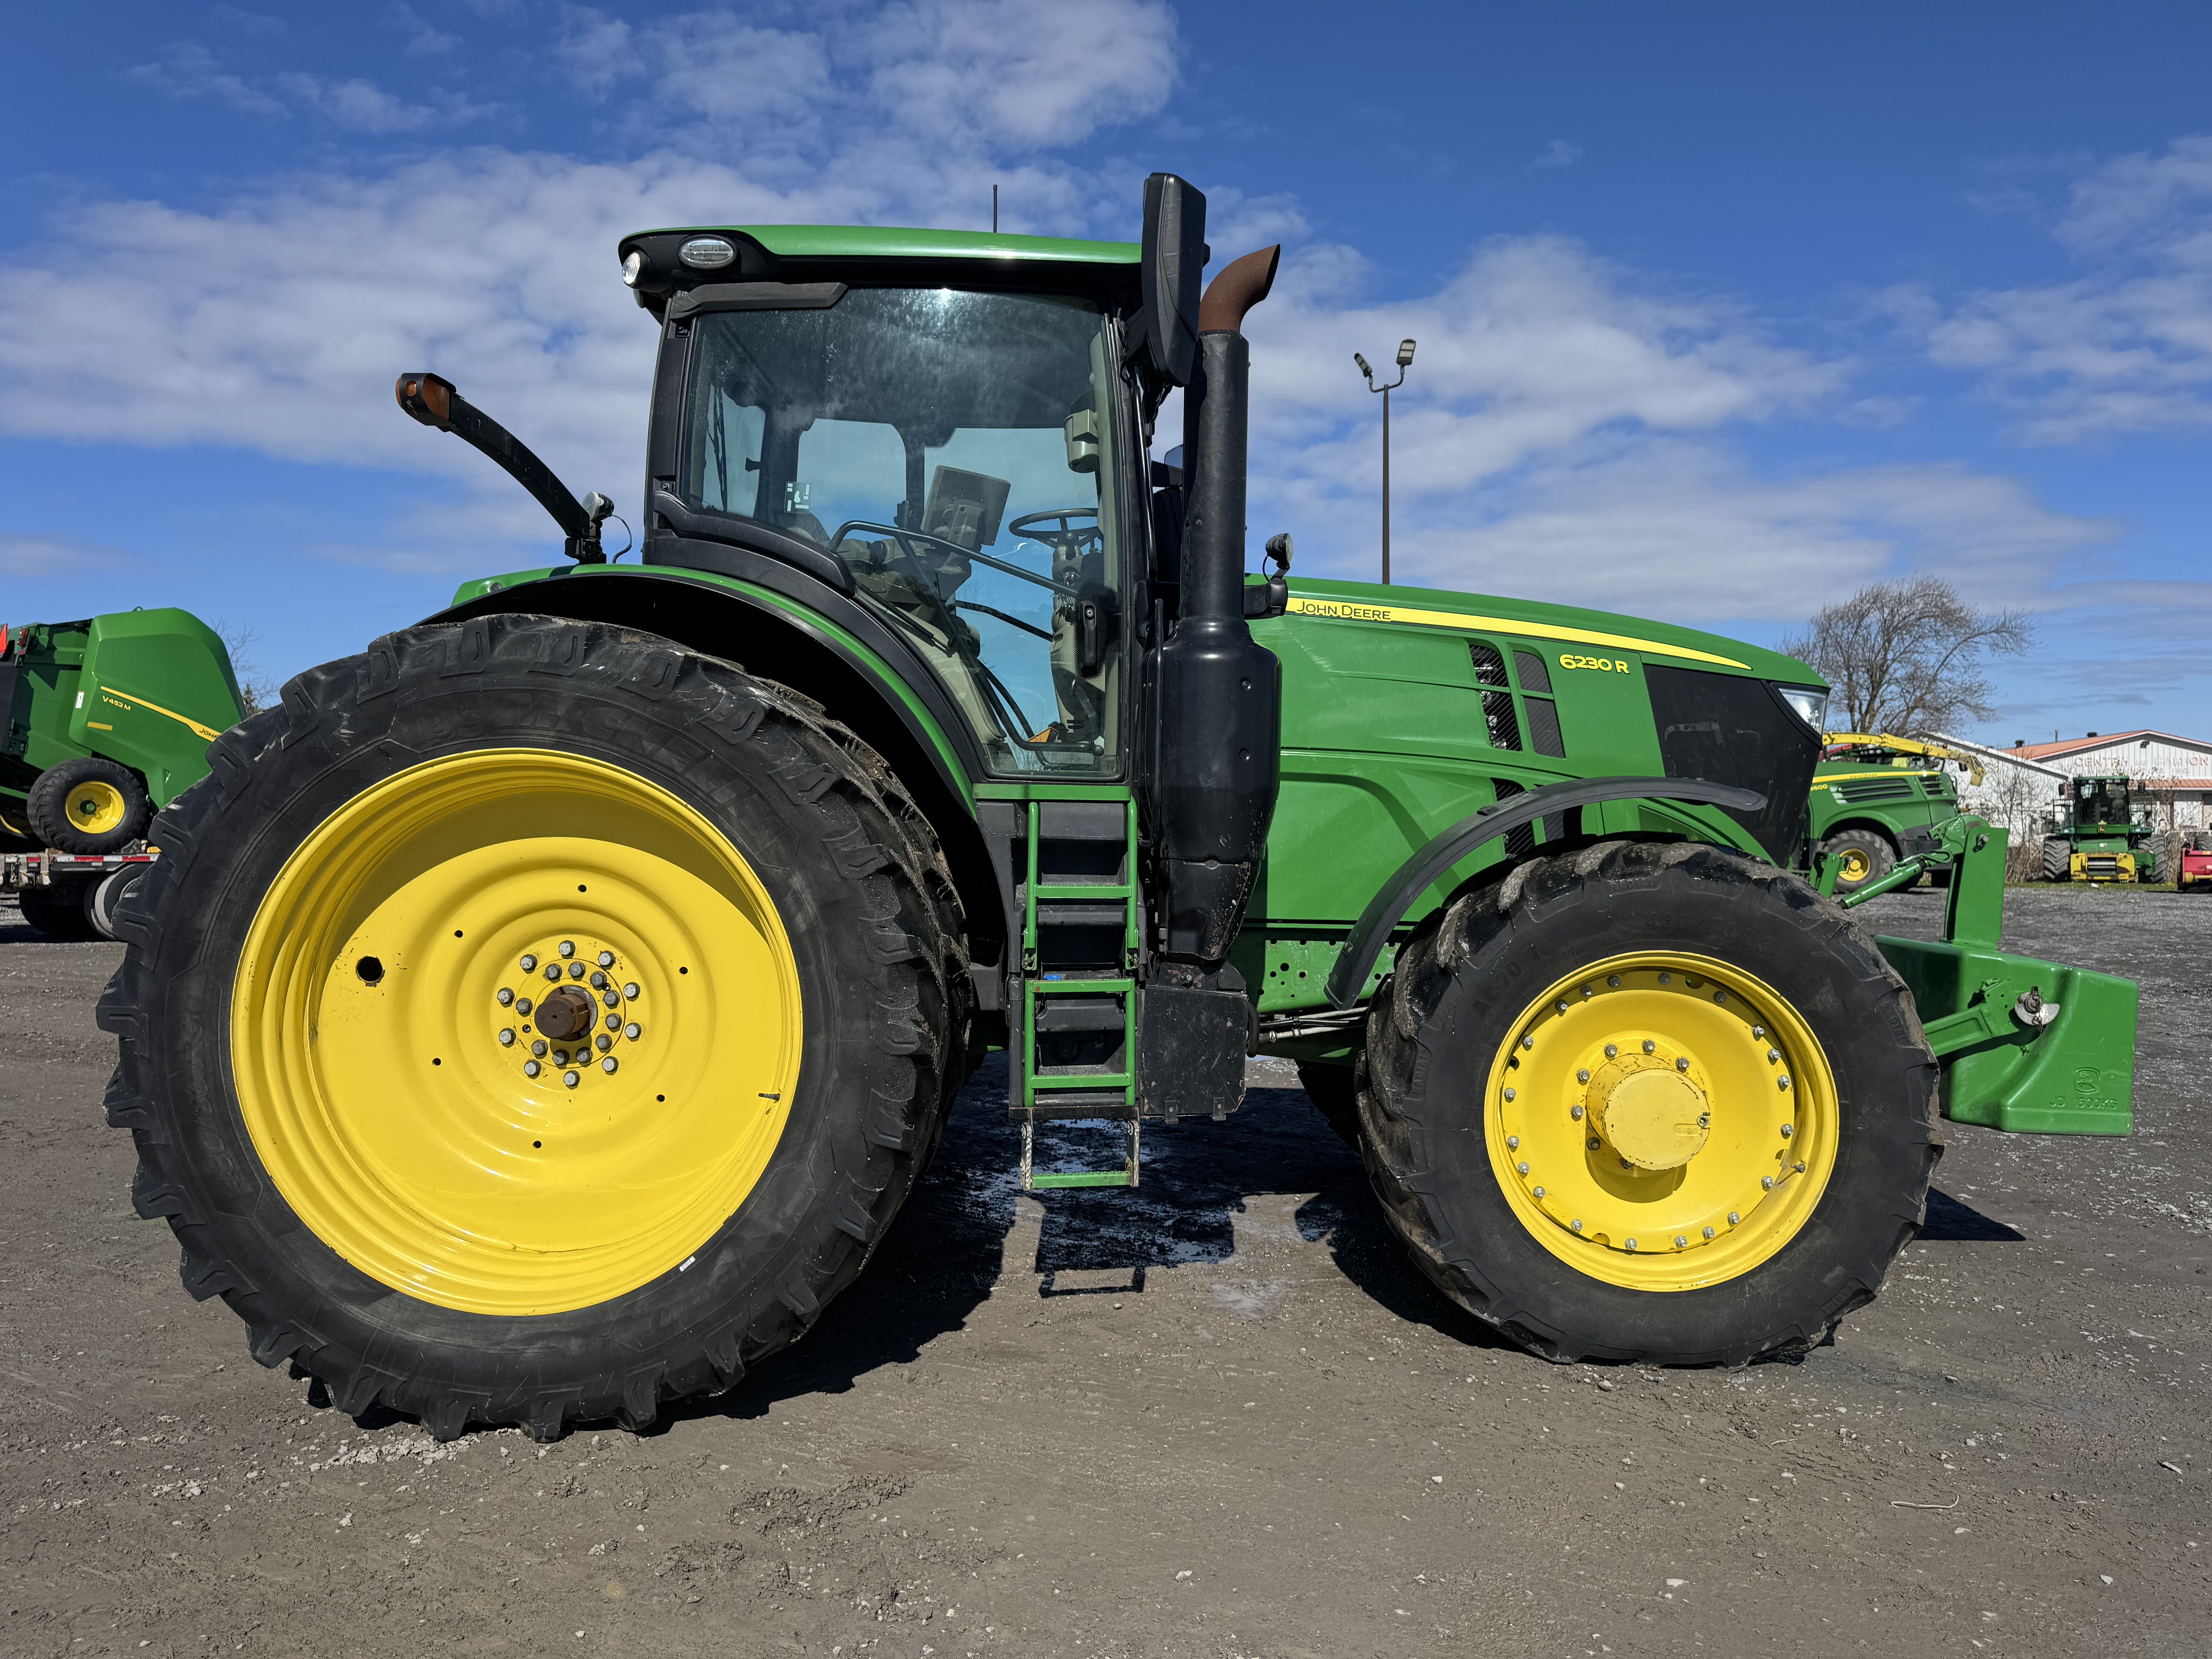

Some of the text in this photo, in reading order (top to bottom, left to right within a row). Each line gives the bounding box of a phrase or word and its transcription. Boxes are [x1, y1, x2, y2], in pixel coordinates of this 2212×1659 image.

[1297, 601, 1391, 620] JOHN DEERE
[2049, 1096, 2118, 1109] JD 1500KG
